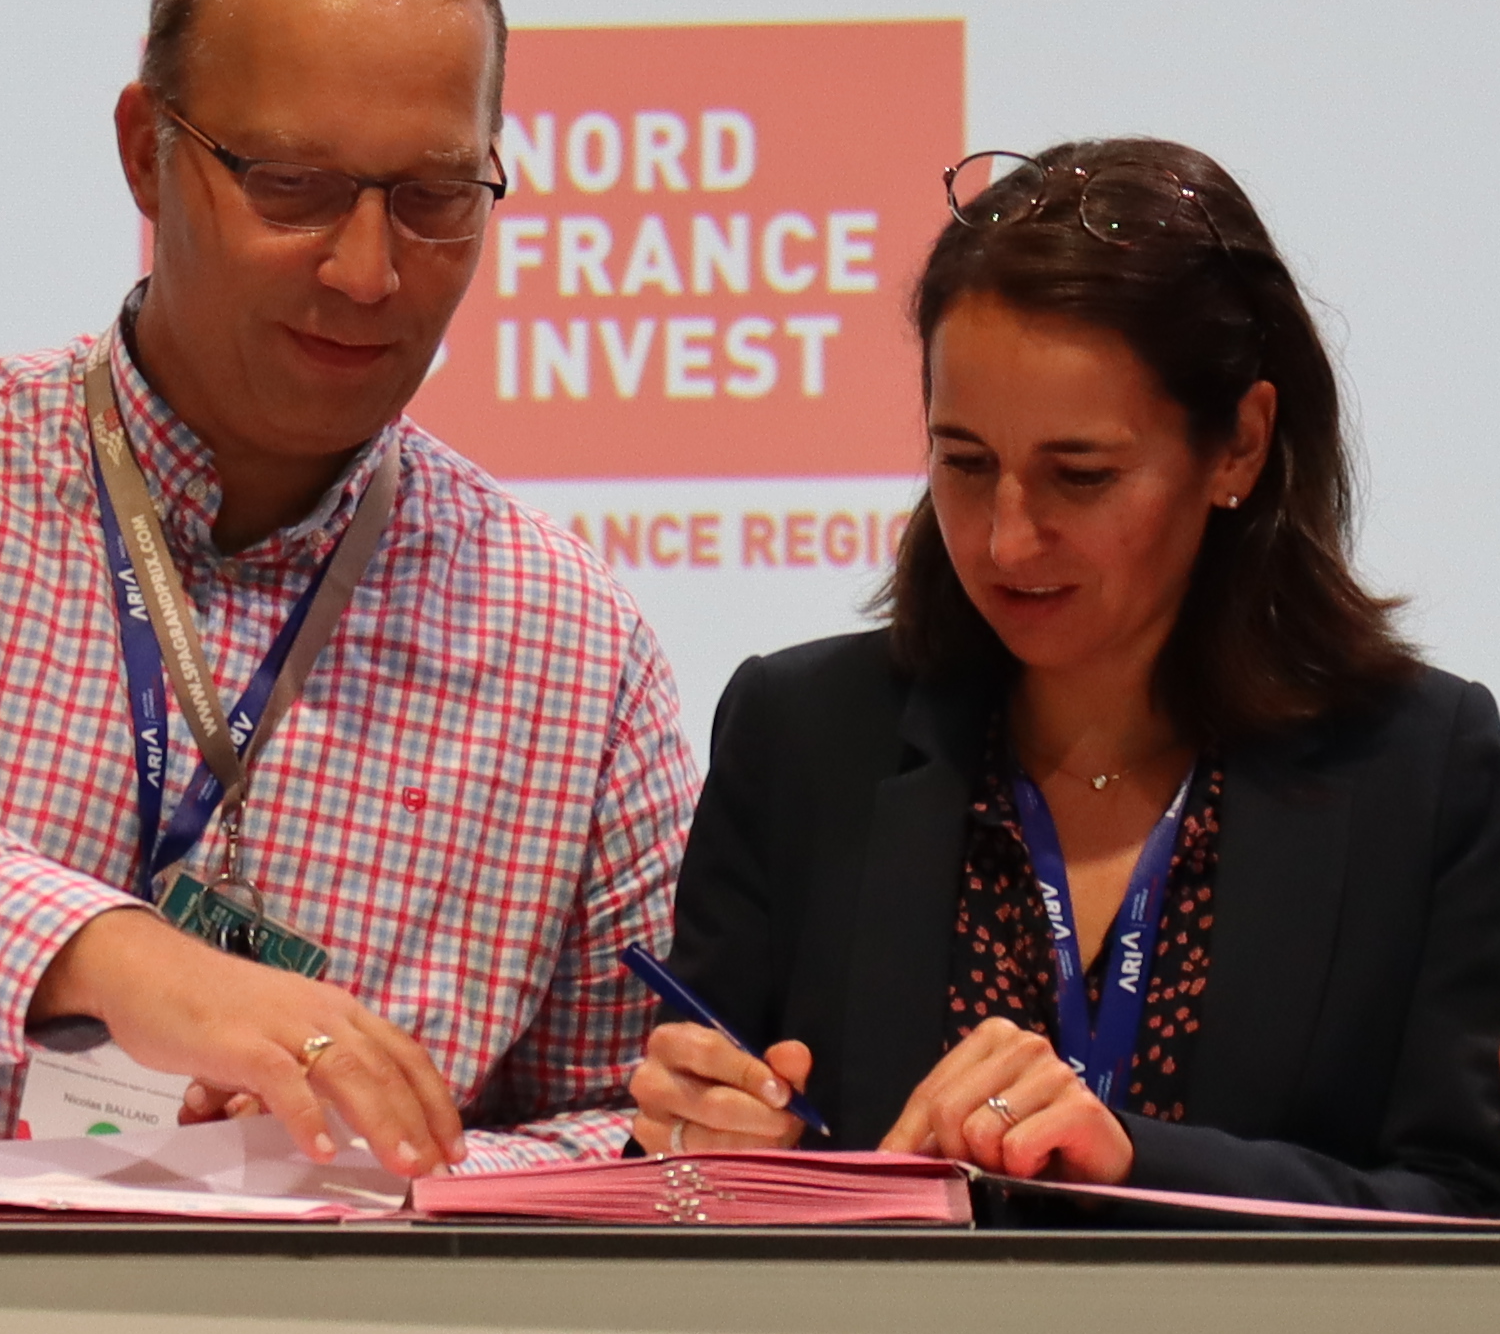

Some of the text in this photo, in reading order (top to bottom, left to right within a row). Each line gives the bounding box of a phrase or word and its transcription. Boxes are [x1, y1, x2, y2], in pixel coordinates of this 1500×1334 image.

[502, 108, 756, 193] NORD
[497, 211, 880, 295] FRANCE
[497, 315, 841, 401] INVEST
[118, 568, 148, 621] ARIA
[141, 727, 163, 788] ARIA
[1039, 881, 1071, 940] ARIA
[1119, 931, 1143, 994] ARIA
